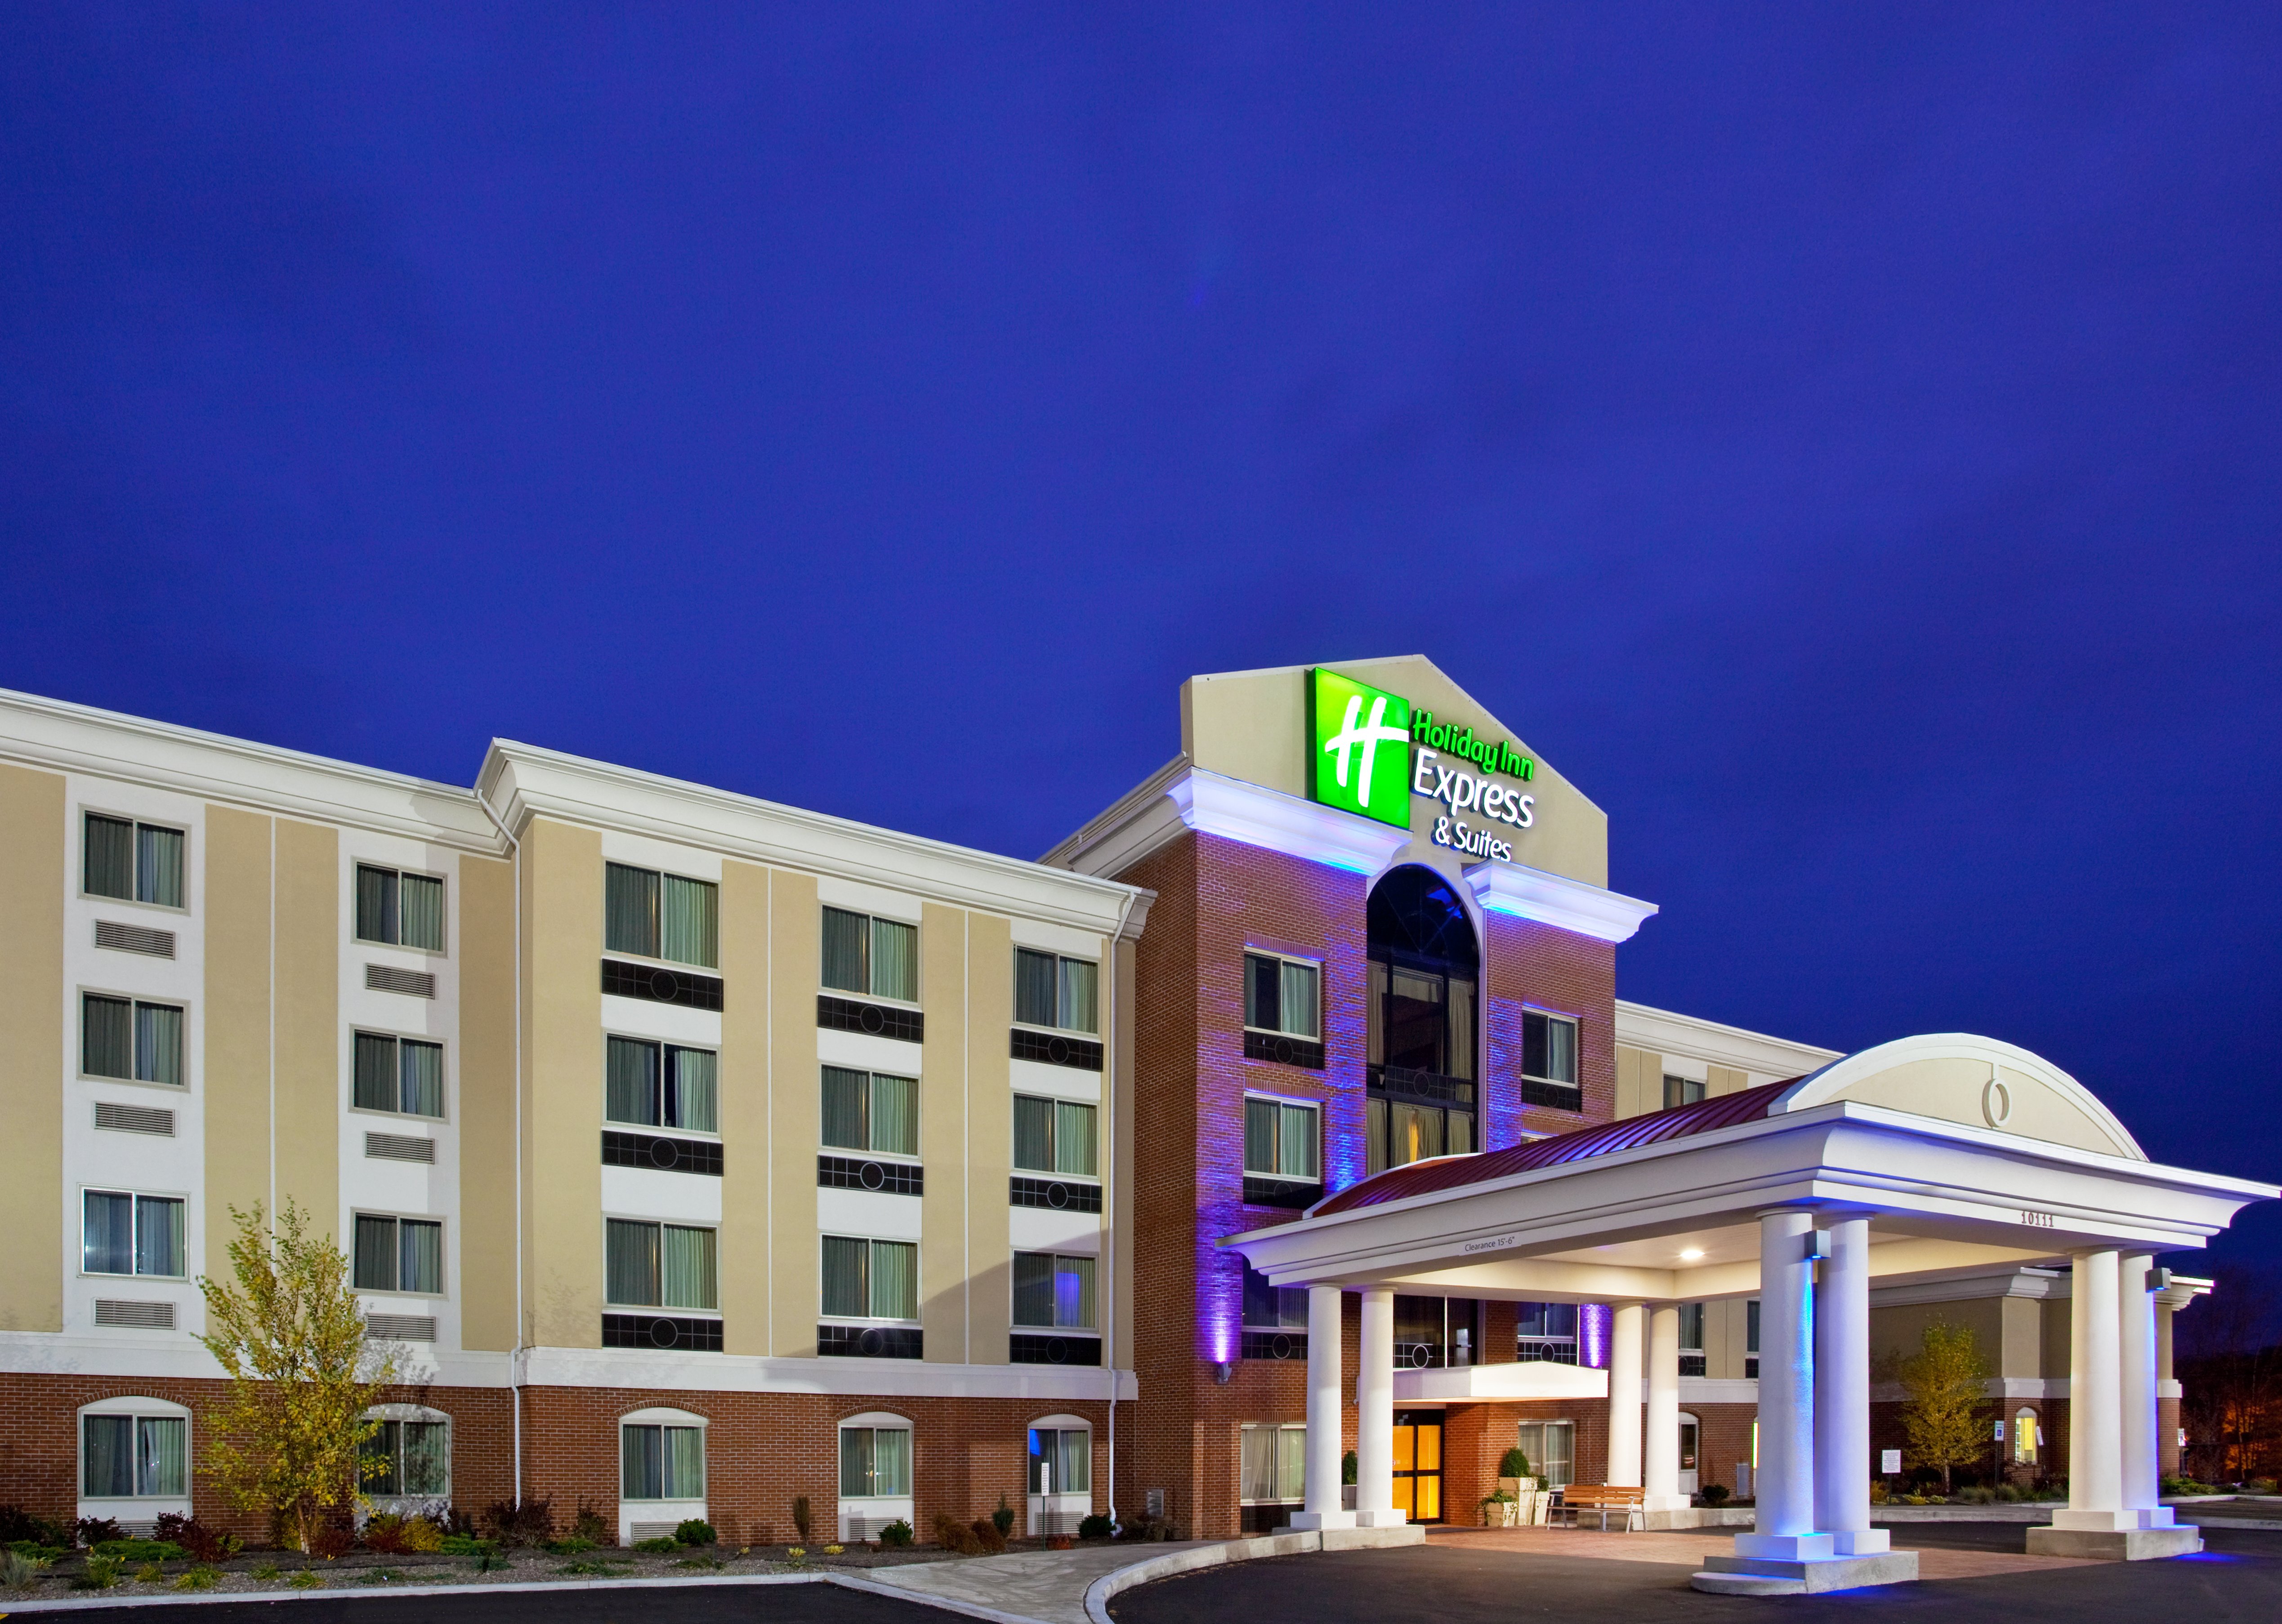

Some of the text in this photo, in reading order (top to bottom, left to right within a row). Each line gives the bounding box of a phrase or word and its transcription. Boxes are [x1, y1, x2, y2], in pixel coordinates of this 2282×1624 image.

[1413, 709, 1534, 781] Holiday Inn
[1413, 748, 1535, 828] Express
[1435, 816, 1512, 862] & Suites
[2021, 1210, 2054, 1227] 10111
[1465, 1236, 1515, 1252] Clearance 15'-6"
